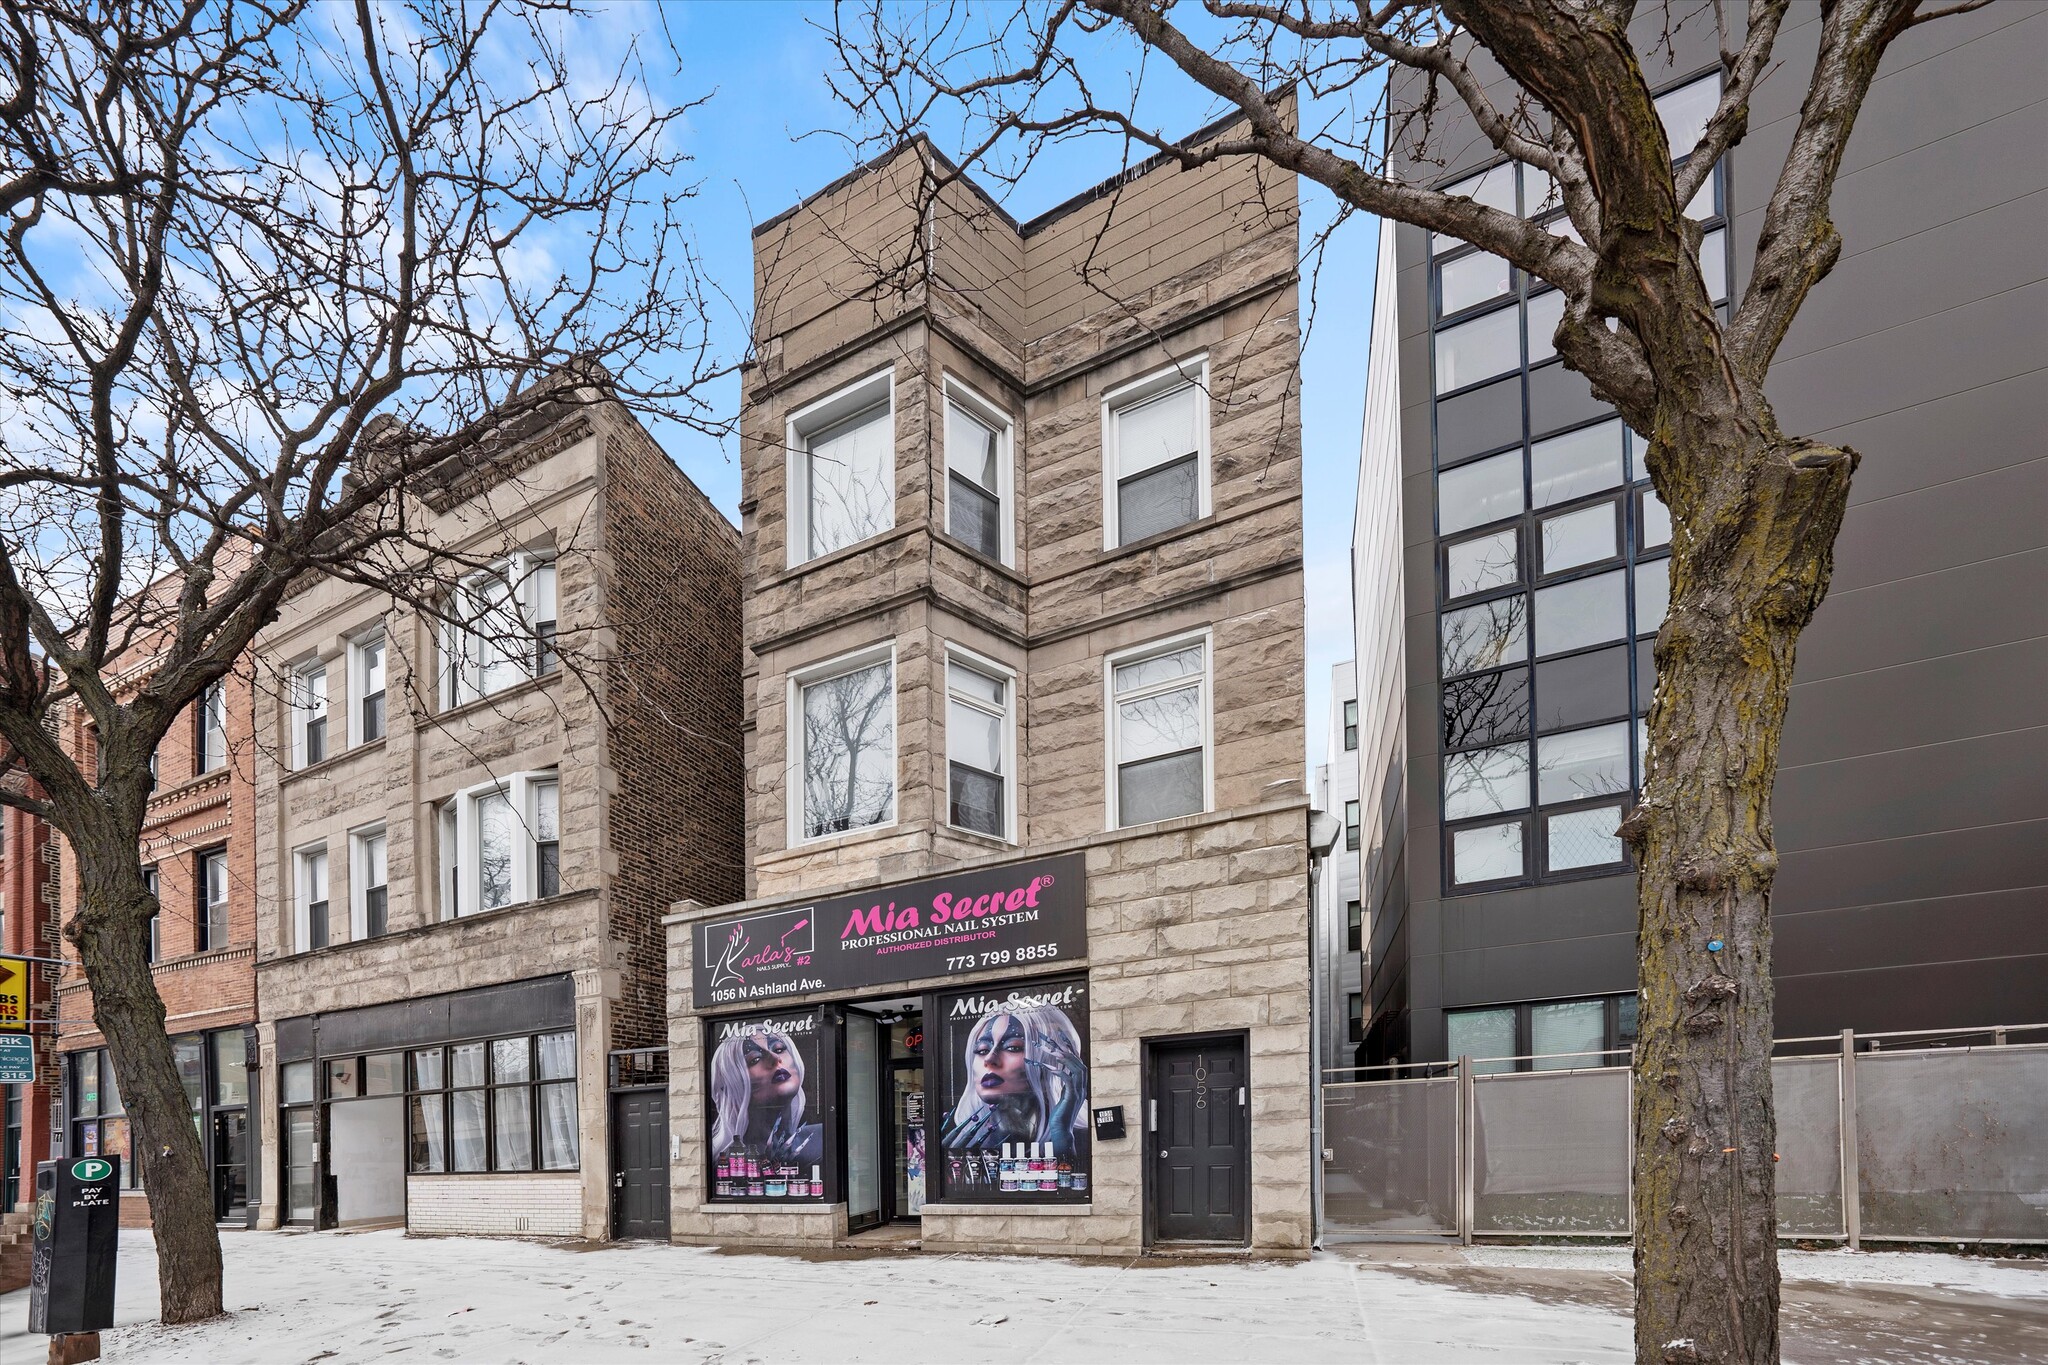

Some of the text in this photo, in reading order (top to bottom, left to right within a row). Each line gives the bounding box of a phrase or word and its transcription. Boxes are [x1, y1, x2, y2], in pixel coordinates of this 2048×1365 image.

[840, 901, 919, 939] Mia
[841, 910, 1040, 951] PROFESSIONAL NAIL SYSTEM
[876, 930, 996, 955] AUTHORIZED DISTRIBUTOR
[797, 955, 811, 966] #2
[946, 943, 1058, 970] 773 799 8855
[710, 978, 826, 1002] 1056 N Ashland Ave.
[949, 995, 999, 1017] Mia
[719, 1014, 813, 1039] Mia Secret
[1195, 1054, 1207, 1109] 1056
[85, 1162, 103, 1178] P
[73, 1199, 109, 1207] PLATE
